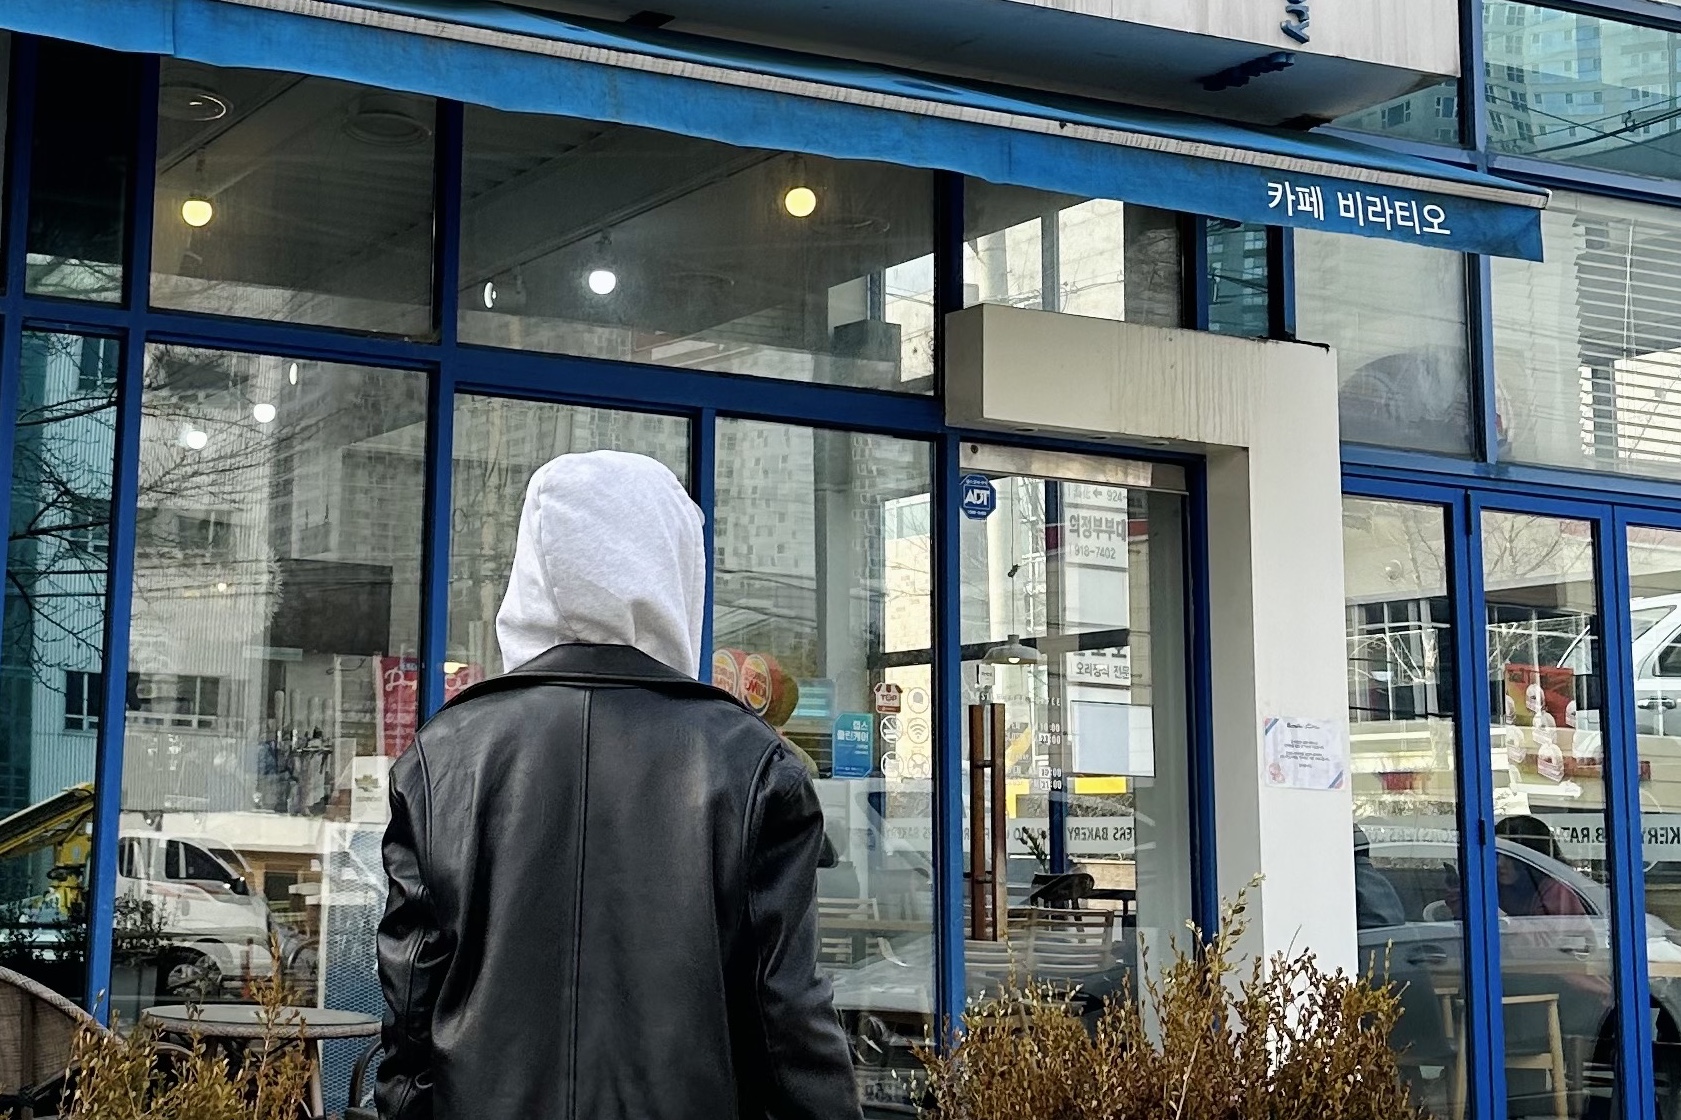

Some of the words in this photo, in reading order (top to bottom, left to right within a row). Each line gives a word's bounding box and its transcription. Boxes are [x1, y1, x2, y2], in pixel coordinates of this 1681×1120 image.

[1267, 181, 1325, 221] 카페
[1337, 191, 1451, 235] 비라티오
[964, 488, 990, 506] ADT
